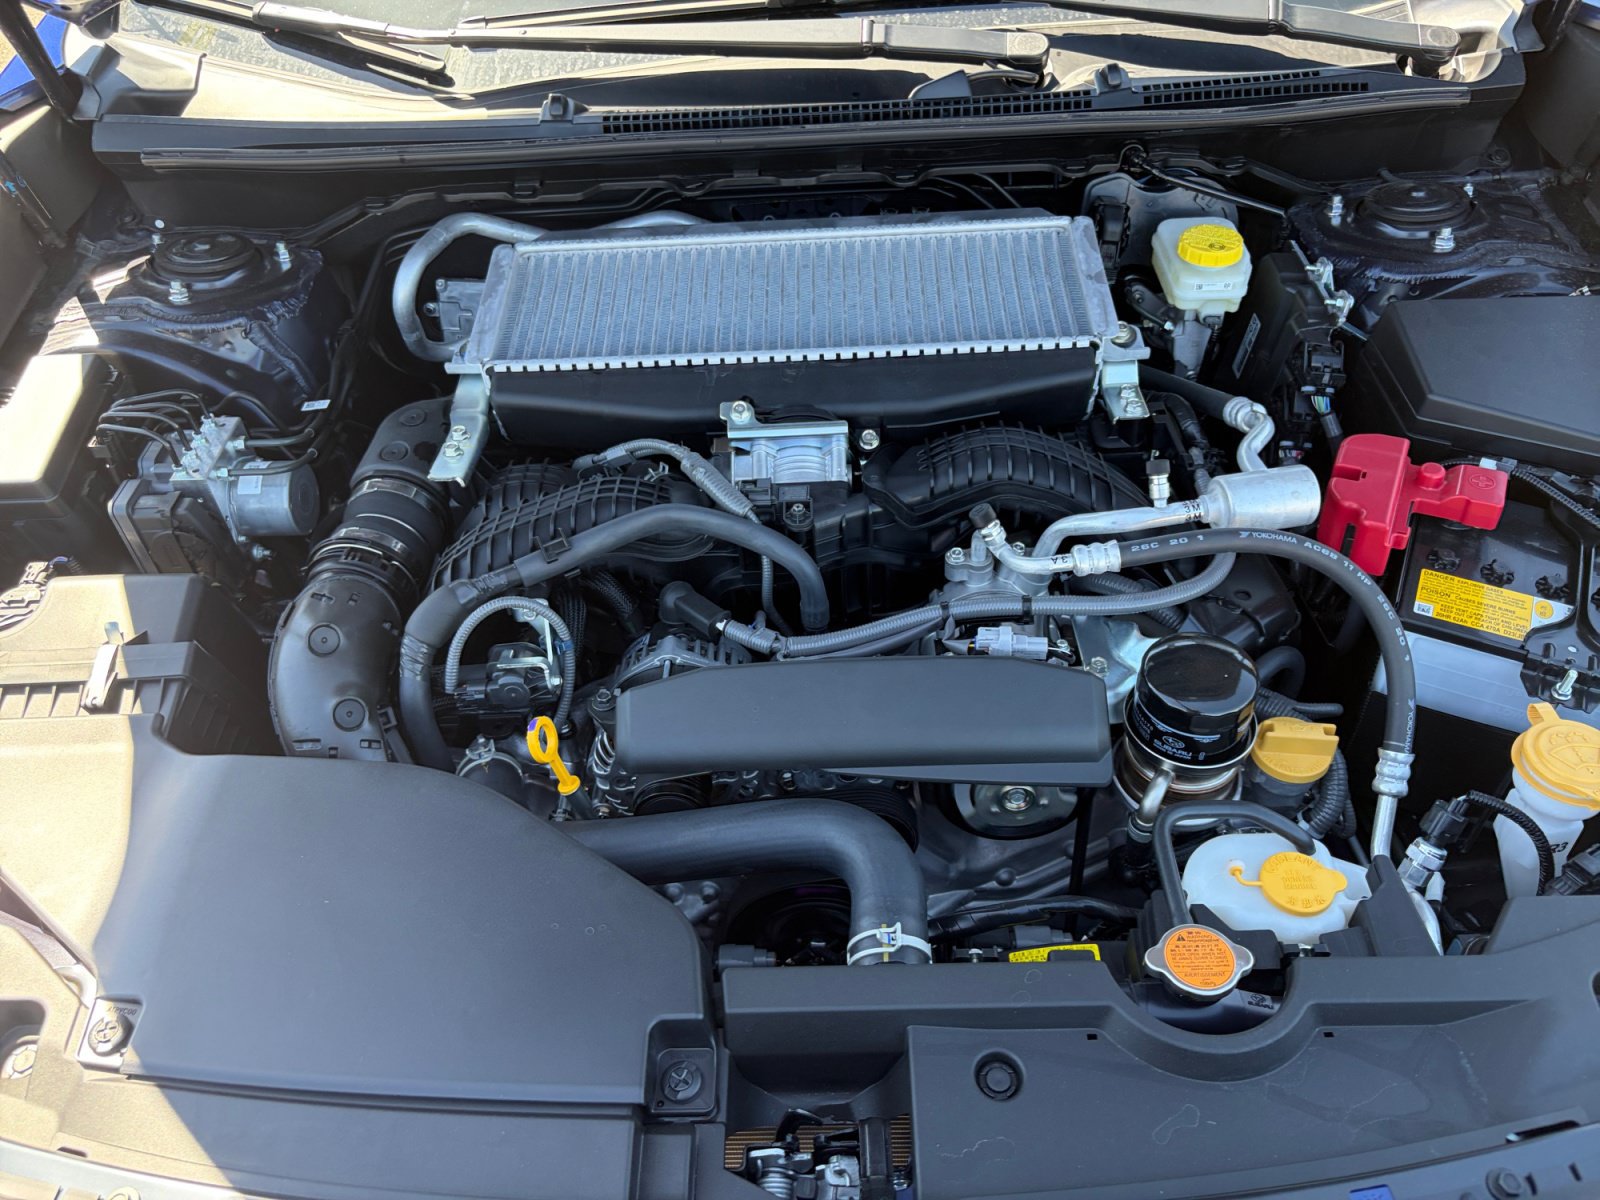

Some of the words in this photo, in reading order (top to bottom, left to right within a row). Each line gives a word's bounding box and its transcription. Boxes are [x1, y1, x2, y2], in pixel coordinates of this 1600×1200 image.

[1251, 531, 1298, 544] YOKOHAMA
[1423, 570, 1455, 582] DANGER
[1420, 586, 1450, 598] POISON
